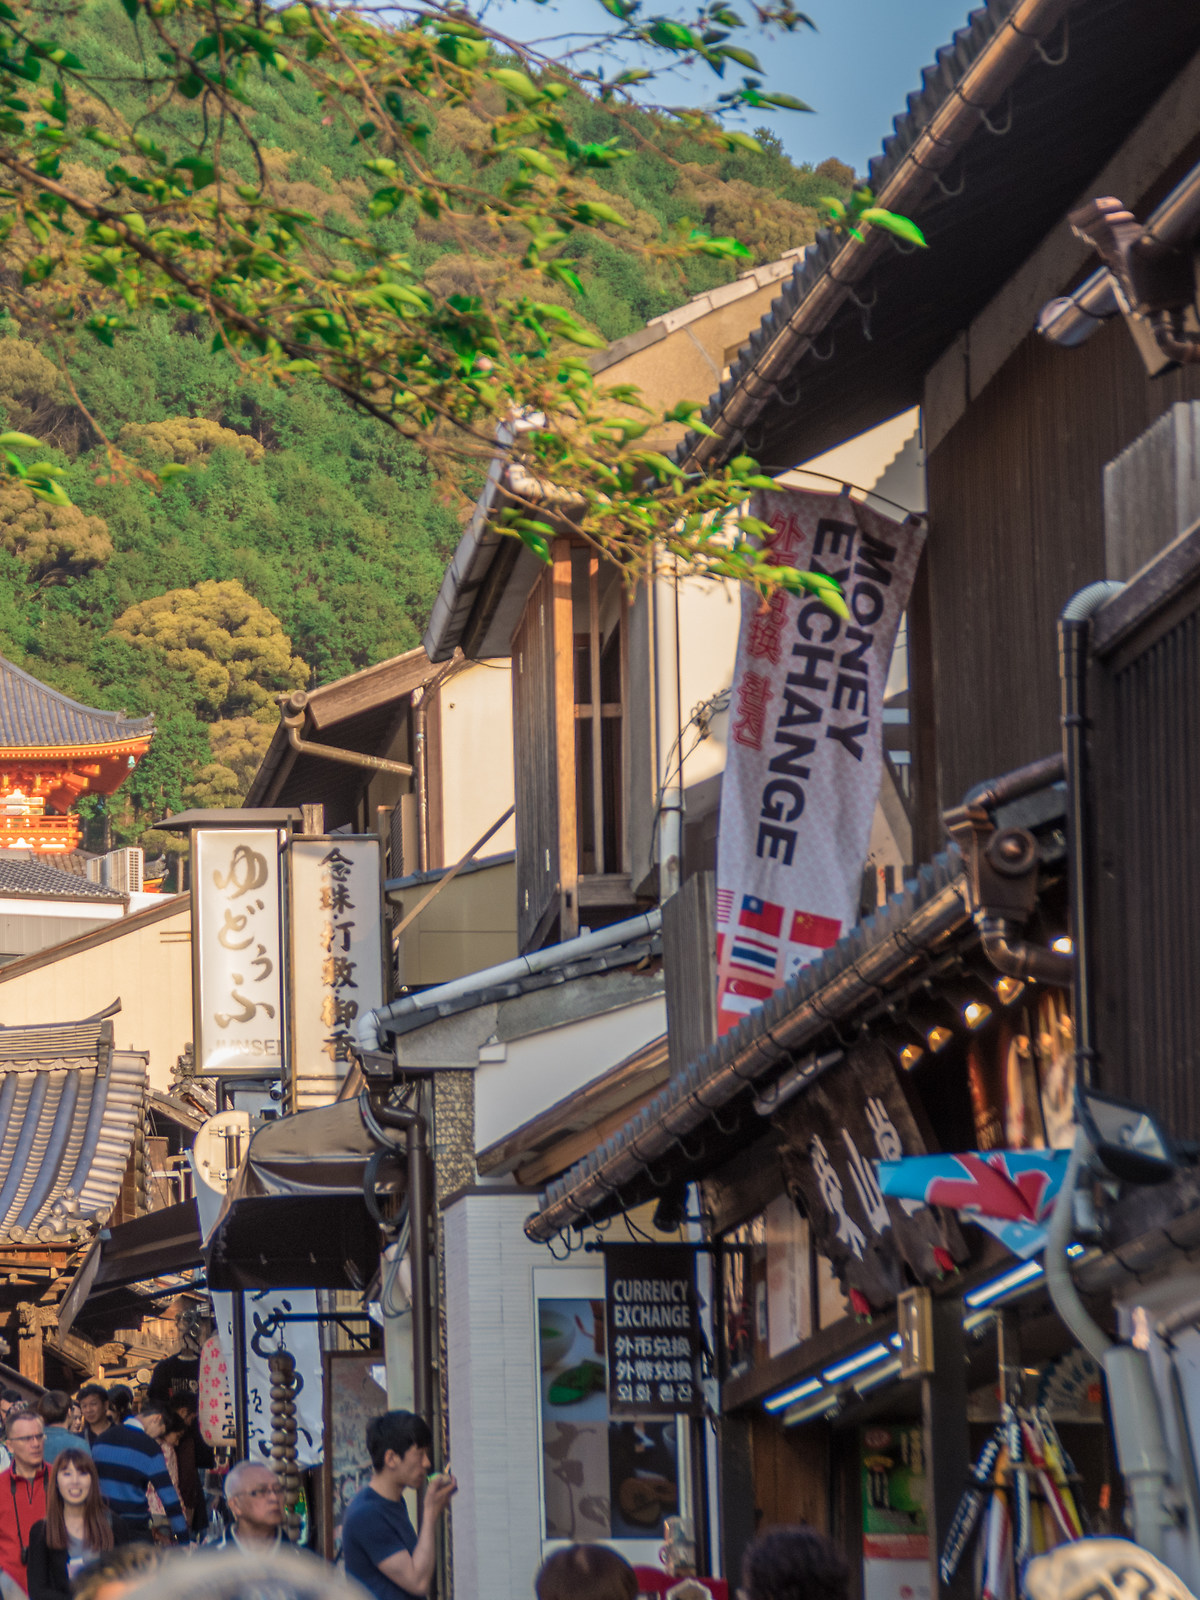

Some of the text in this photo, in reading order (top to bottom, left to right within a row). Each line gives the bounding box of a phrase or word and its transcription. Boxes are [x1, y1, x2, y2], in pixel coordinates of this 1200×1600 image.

[756, 519, 855, 866] EXCHANGE
[826, 532, 897, 761] MONEY
[212, 844, 275, 1029] ゆどうふ
[613, 1280, 689, 1303] CURRENCY
[614, 1304, 691, 1328] EXCHANGE
